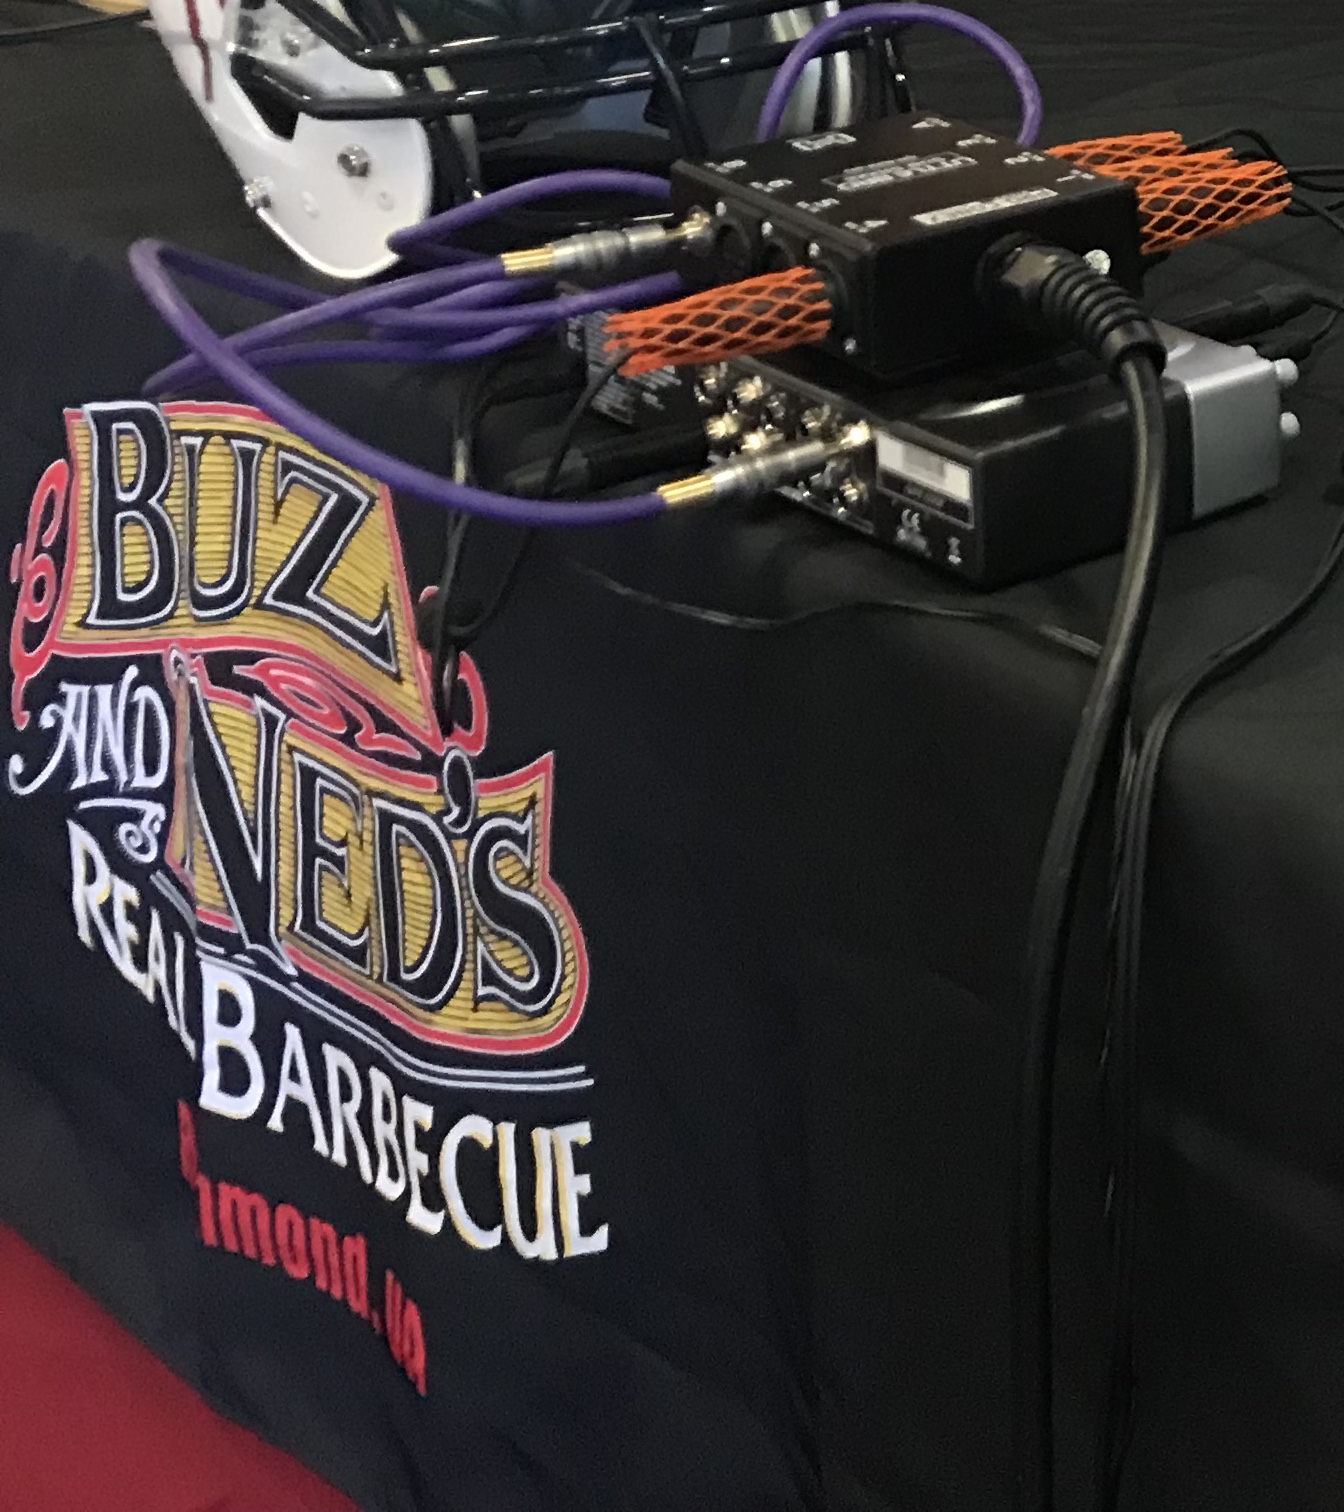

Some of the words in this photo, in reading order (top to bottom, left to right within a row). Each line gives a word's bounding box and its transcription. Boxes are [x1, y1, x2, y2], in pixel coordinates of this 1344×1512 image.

[80, 400, 400, 679] BUZ
[9, 664, 170, 796] AND
[180, 674, 563, 1014] NED'S
[65, 818, 197, 1062] REAL
[199, 961, 609, 1261] BARBECUE
